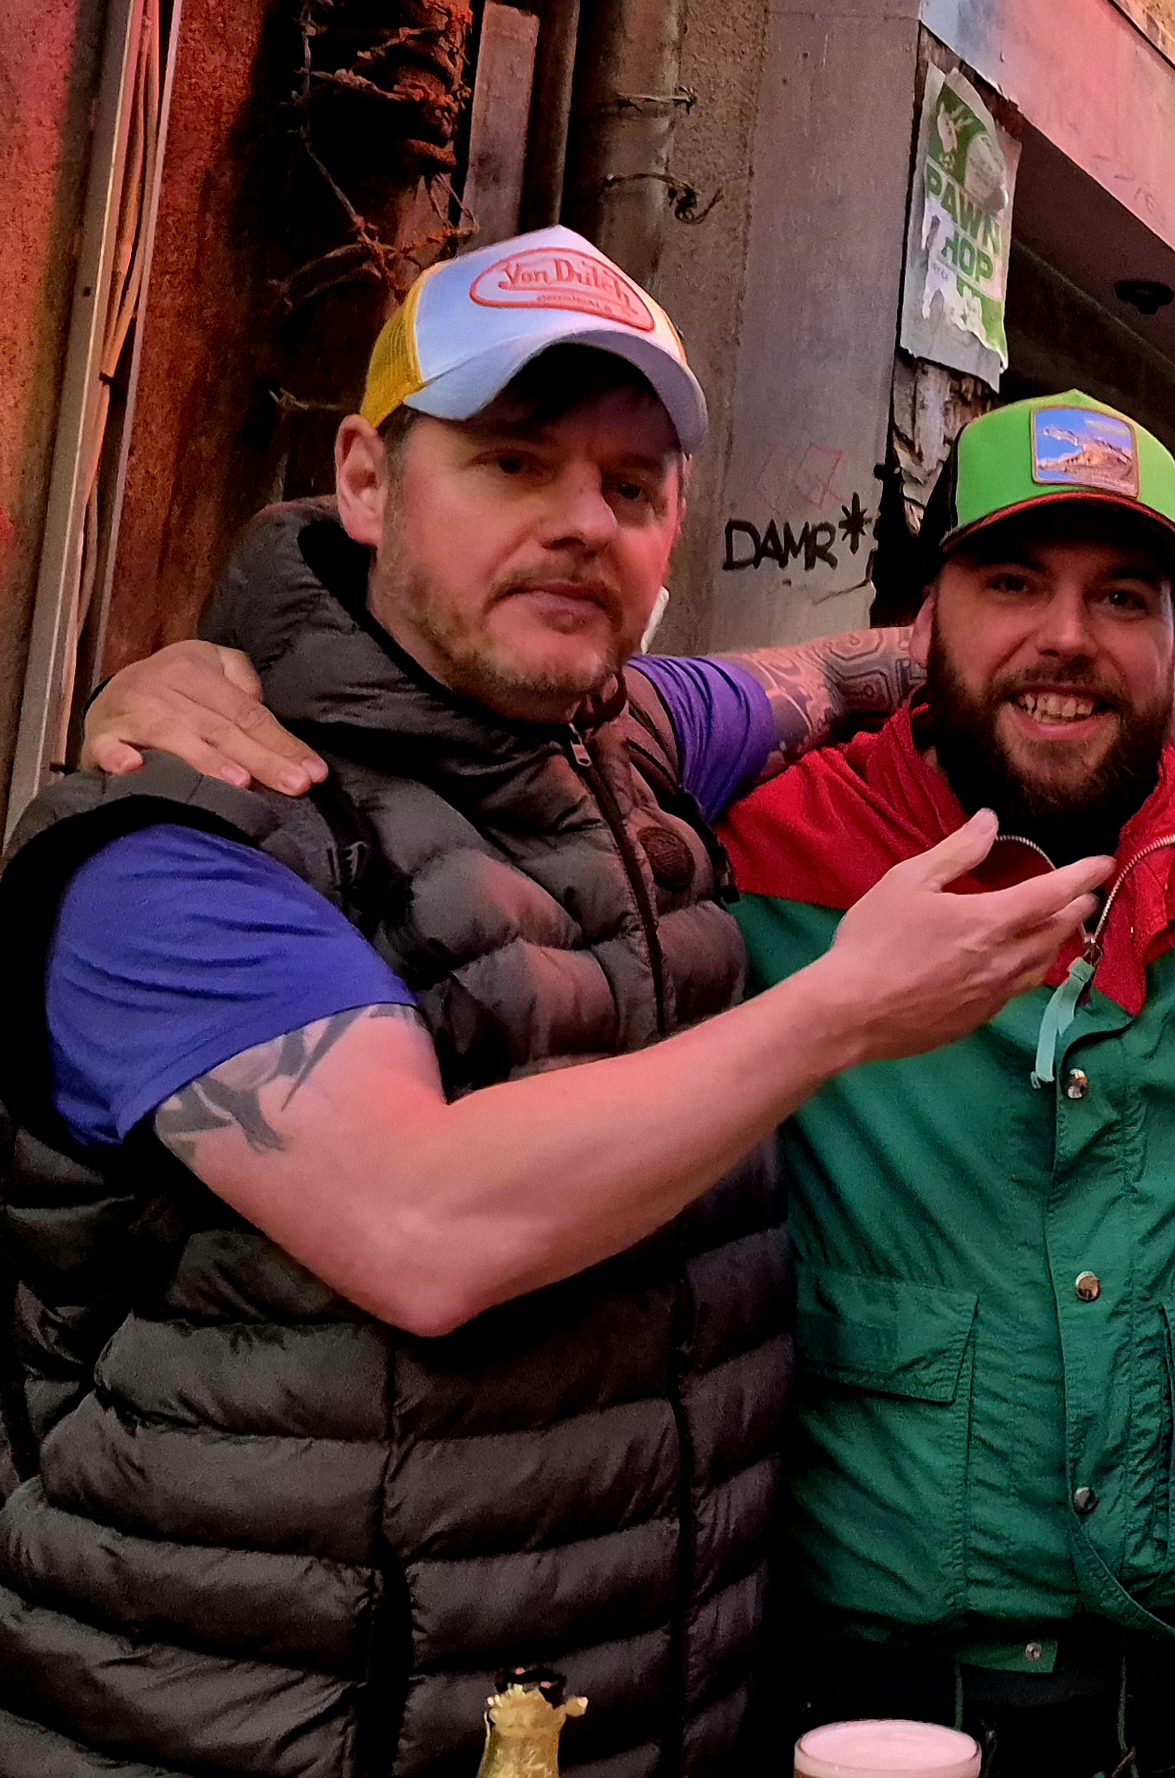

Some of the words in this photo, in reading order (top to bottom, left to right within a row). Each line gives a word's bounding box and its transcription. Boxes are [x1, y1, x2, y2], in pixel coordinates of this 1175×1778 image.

[926, 163, 1001, 256] PAWN
[939, 230, 994, 282] HOP
[553, 258, 639, 316] Dutch
